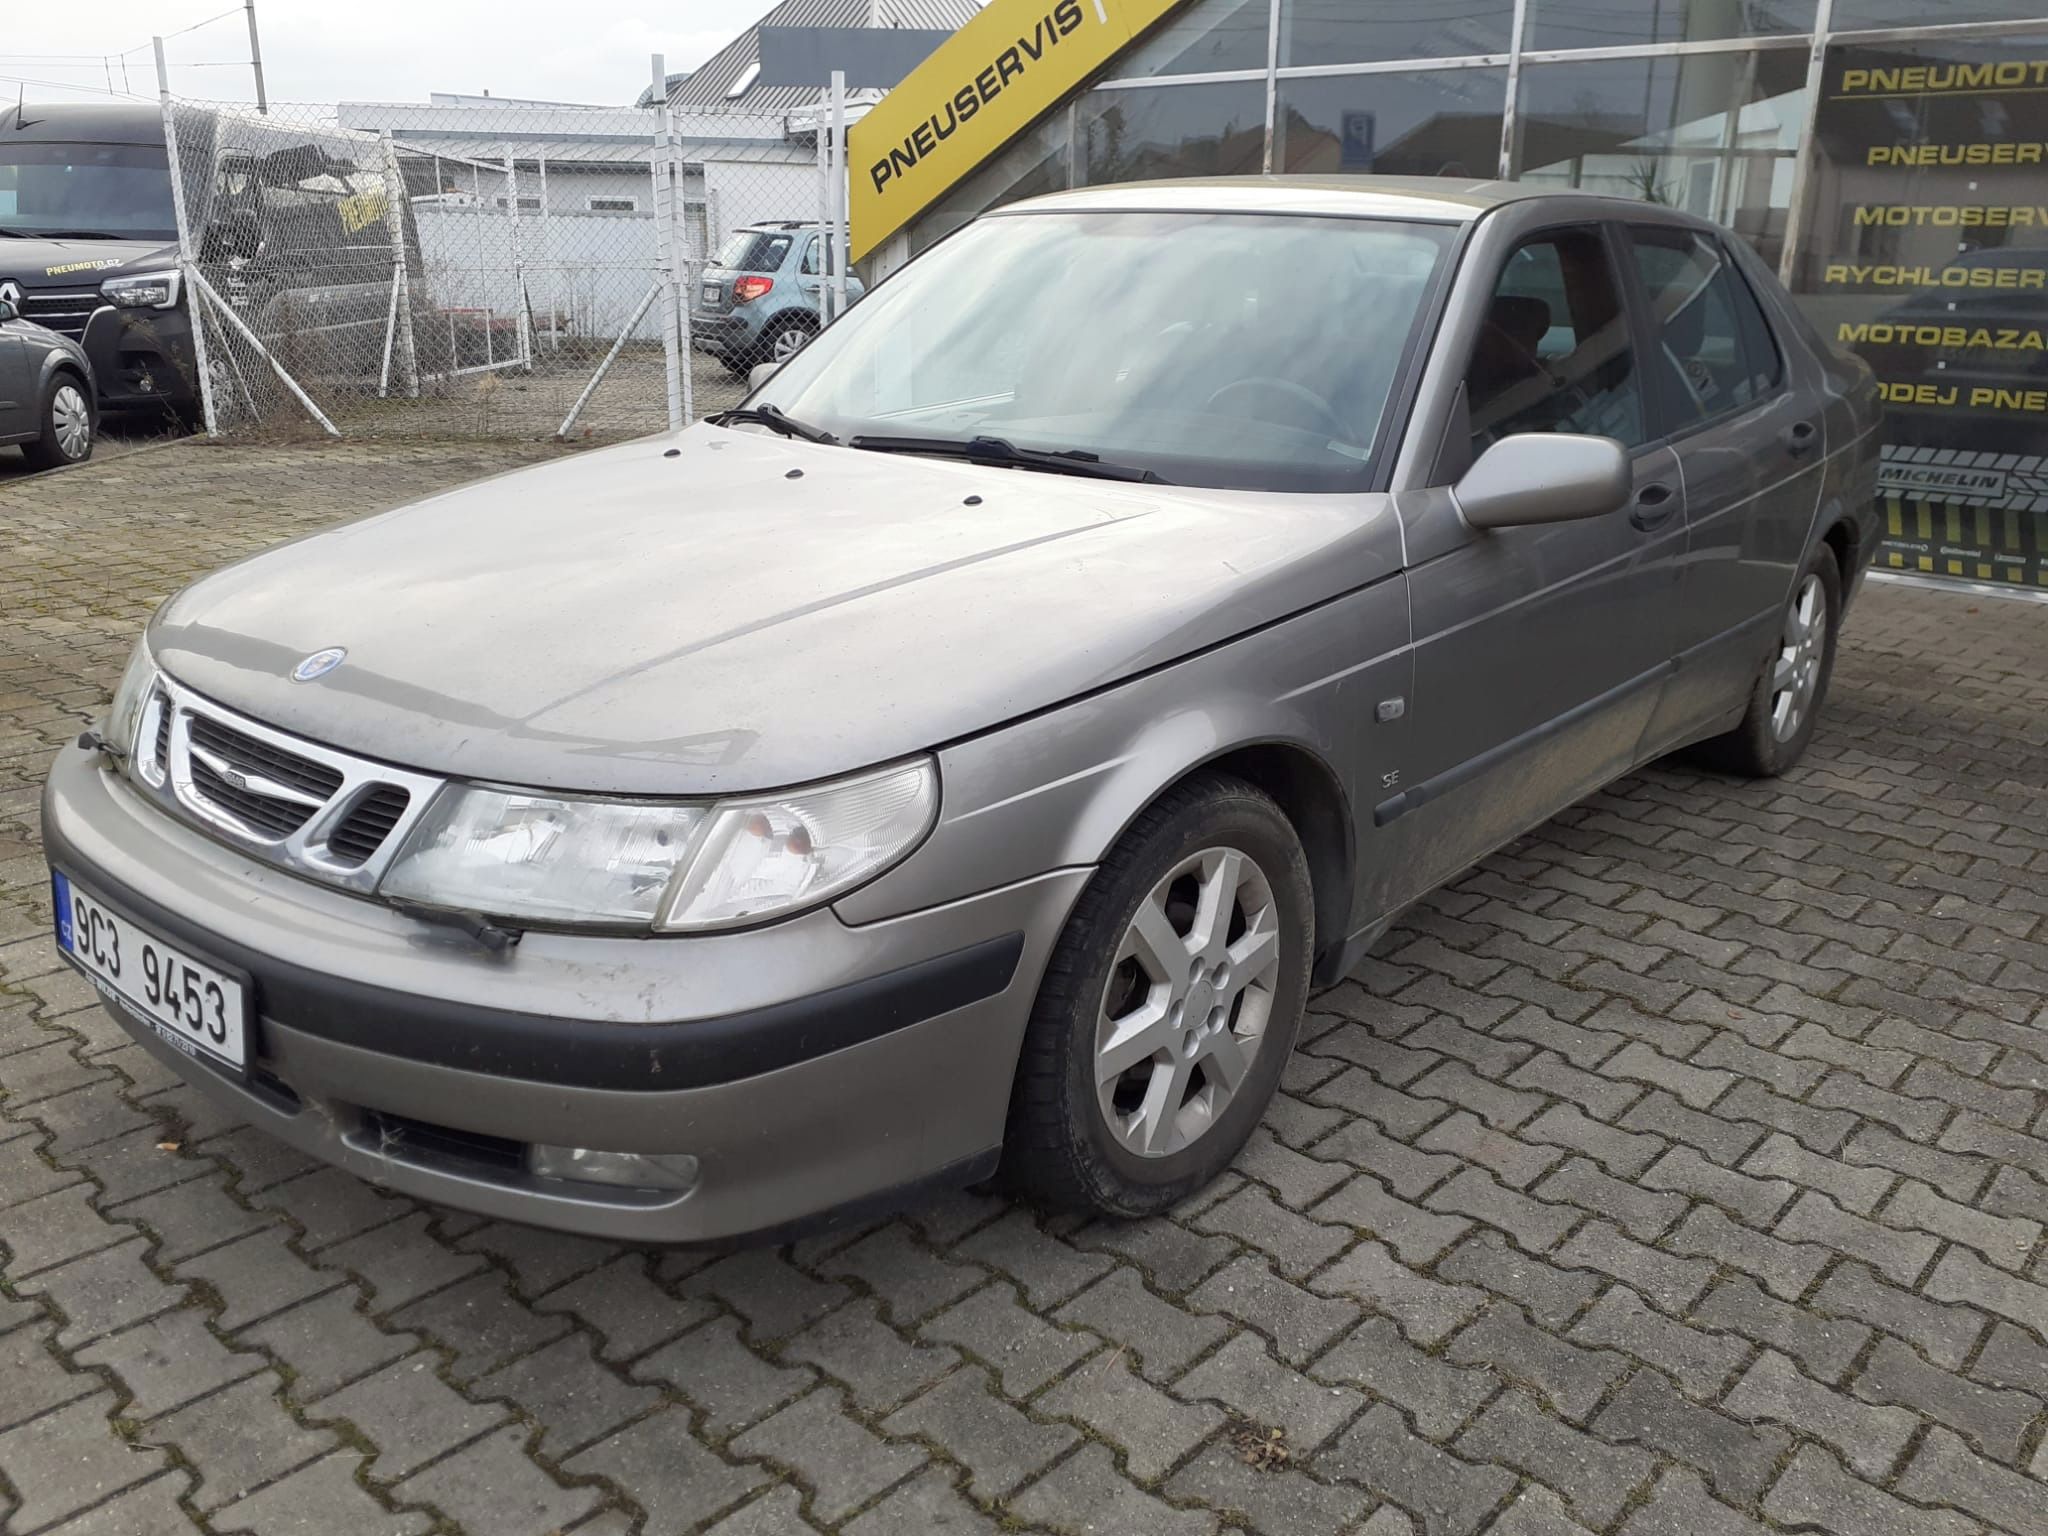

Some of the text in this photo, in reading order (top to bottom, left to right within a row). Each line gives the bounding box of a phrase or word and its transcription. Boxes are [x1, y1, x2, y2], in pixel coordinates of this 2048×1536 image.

[870, 0, 1083, 194] PNEUSERVIS
[1866, 143, 2048, 166] PNEUSER
[1838, 323, 2048, 350] MOTOBAZA
[1880, 467, 1999, 489] MICHELIN
[1382, 769, 1400, 789] SE
[61, 920, 73, 942] CZ
[74, 896, 121, 978] 9C3
[142, 944, 227, 1044] 9453
